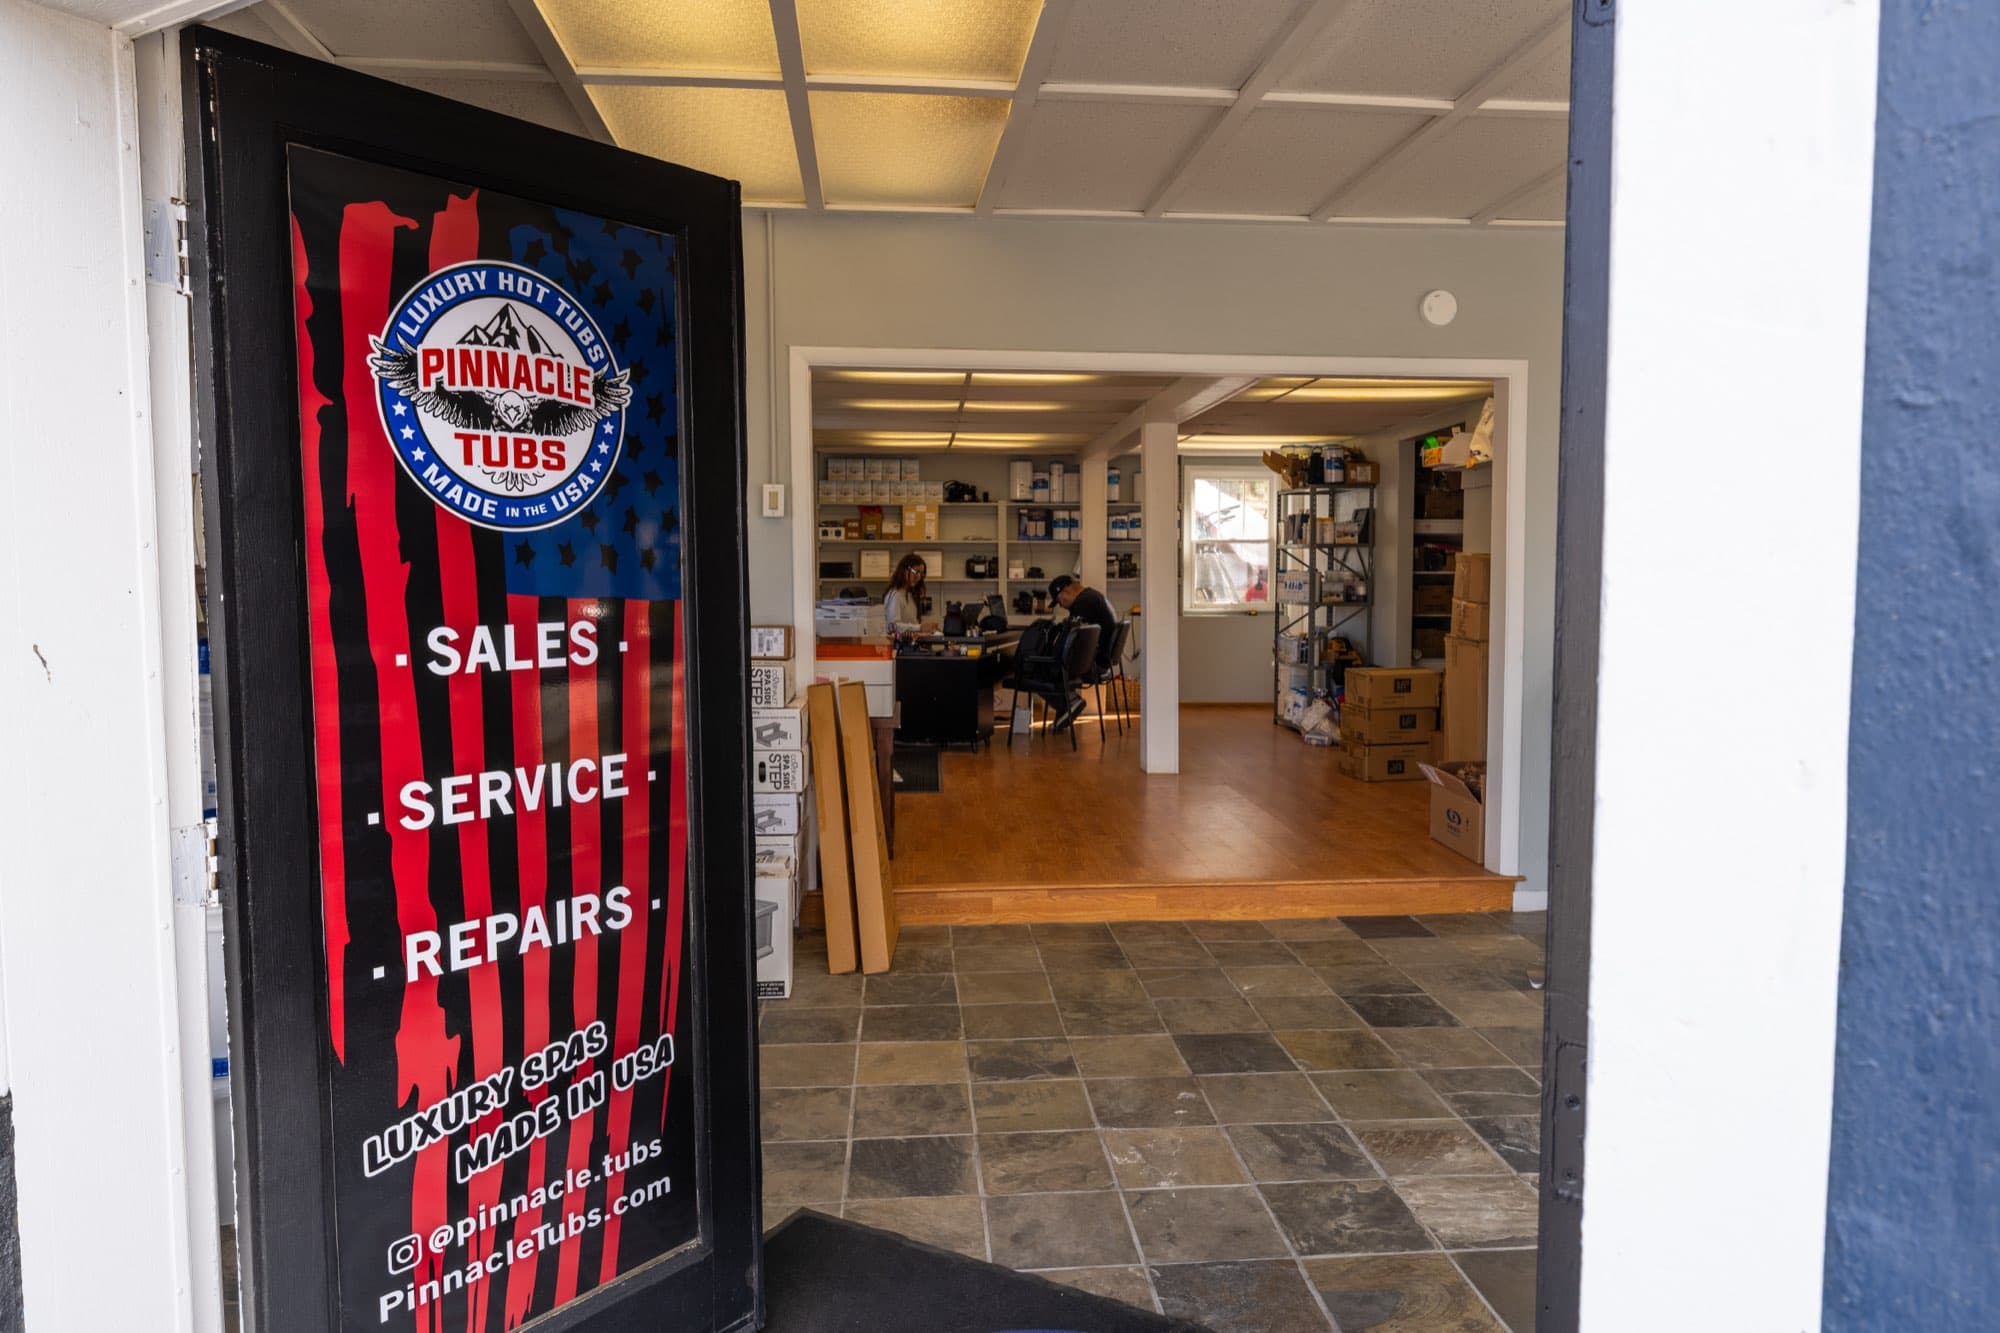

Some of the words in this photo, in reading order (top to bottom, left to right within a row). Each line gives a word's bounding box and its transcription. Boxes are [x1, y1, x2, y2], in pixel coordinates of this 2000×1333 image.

[398, 270, 487, 338] LUXURY
[498, 270, 551, 304] HOT
[555, 297, 605, 364] TUBS
[421, 346, 593, 406] PINNACLE
[421, 462, 499, 520] MADE
[505, 505, 520, 518] IN
[523, 503, 548, 518] THE
[551, 473, 596, 513] USA
[453, 431, 567, 472] TUBS
[426, 620, 599, 676] SALES
[751, 668, 763, 706] STEP
[398, 752, 630, 831] SERVICE
[768, 753, 782, 791] STEP
[405, 885, 633, 983] REPAIRS
[362, 1066, 515, 1178] LUXURY
[521, 1020, 608, 1091] SPAS
[455, 1097, 561, 1185] MADE
[567, 1071, 605, 1121] IN
[612, 1032, 675, 1092] USA
[428, 1138, 663, 1252] @pinnacle.tubs
[378, 1175, 671, 1324] PinnacleTubs.com
